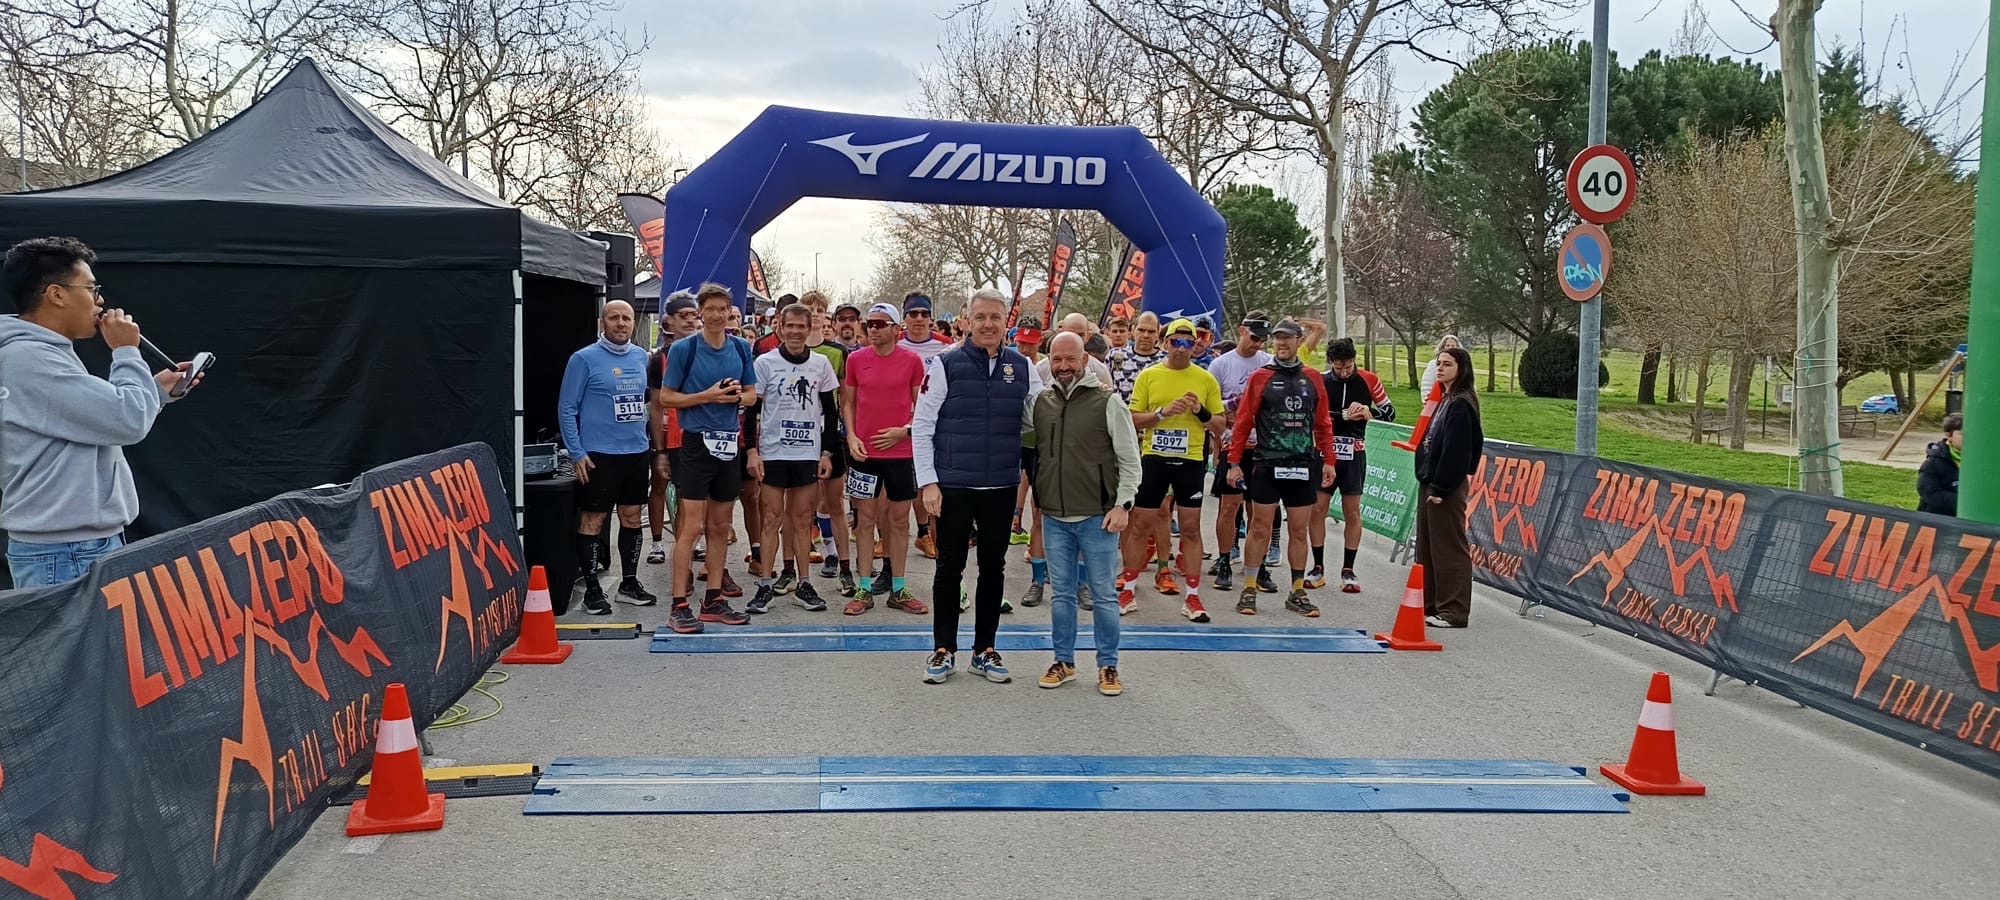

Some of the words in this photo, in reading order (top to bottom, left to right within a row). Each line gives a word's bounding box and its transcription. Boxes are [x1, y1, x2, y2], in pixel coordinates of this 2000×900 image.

[1583, 171, 1622, 197] 40
[620, 403, 642, 413] 5116
[715, 441, 728, 451] 47
[785, 429, 810, 439] 5002
[1157, 436, 1182, 446] 5097
[1332, 443, 1349, 452] 094
[849, 478, 869, 492] 5065
[1387, 467, 1397, 482] de
[1489, 456, 1546, 507] ZERO
[369, 476, 447, 570] ZIMA
[430, 459, 490, 534] ZERO
[1583, 469, 1659, 529] ZIMA
[1661, 483, 1746, 550] ZERO
[1809, 508, 1937, 593] ZIMA
[101, 546, 244, 708] ZIMA
[229, 517, 344, 627] ZERO
[1616, 588, 1659, 624] TRAIL
[1659, 603, 1716, 645] SERIES
[1879, 674, 1953, 731] TRAIL
